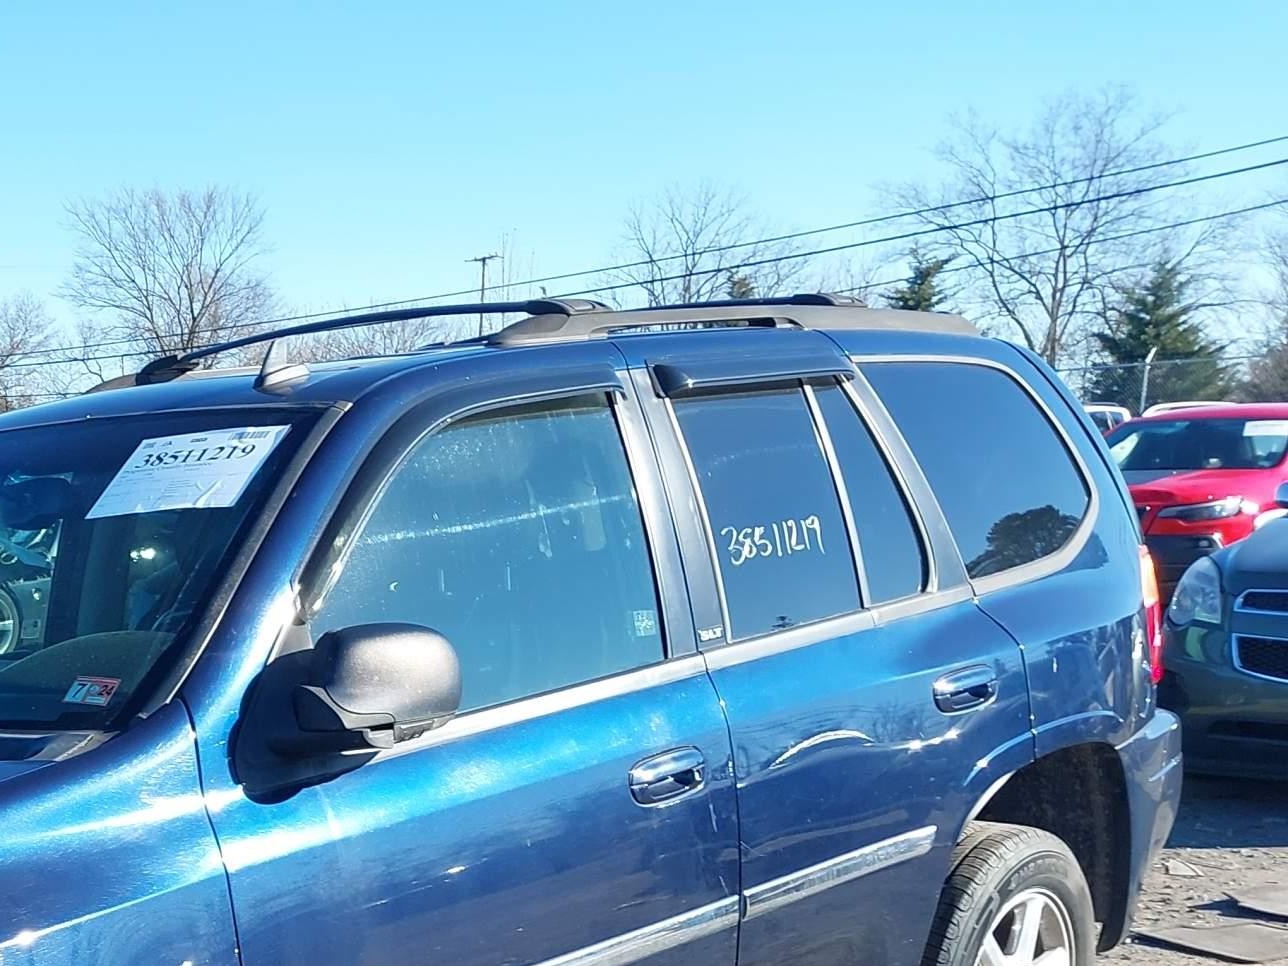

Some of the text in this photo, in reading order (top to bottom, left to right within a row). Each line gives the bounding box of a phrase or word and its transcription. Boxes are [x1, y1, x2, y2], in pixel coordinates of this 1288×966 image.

[134, 444, 256, 469] 38511219
[720, 515, 825, 566] 38511219
[72, 683, 115, 698] 7 24
